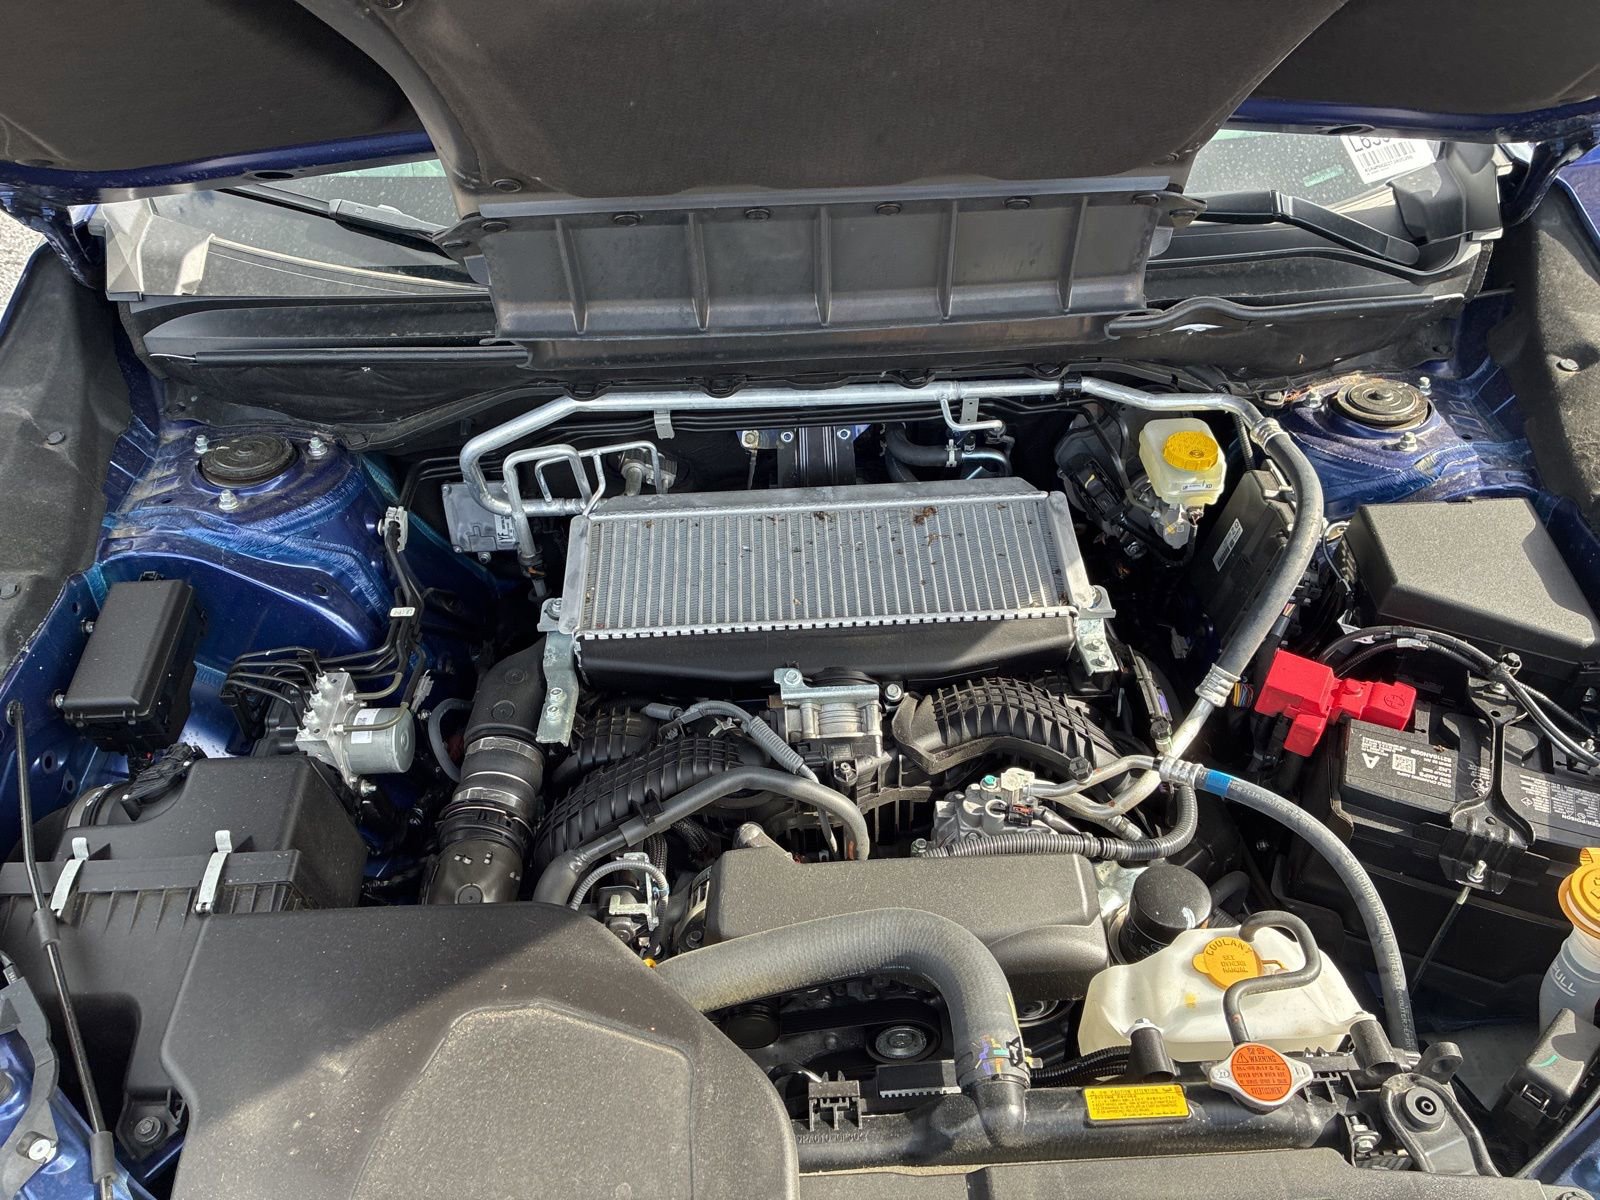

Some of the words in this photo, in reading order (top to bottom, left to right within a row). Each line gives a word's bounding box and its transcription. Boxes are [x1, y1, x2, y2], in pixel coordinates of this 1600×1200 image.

[1206, 939, 1252, 956] COOLANT
[1551, 960, 1577, 993] FULL
[1249, 1055, 1277, 1063] WARNING
